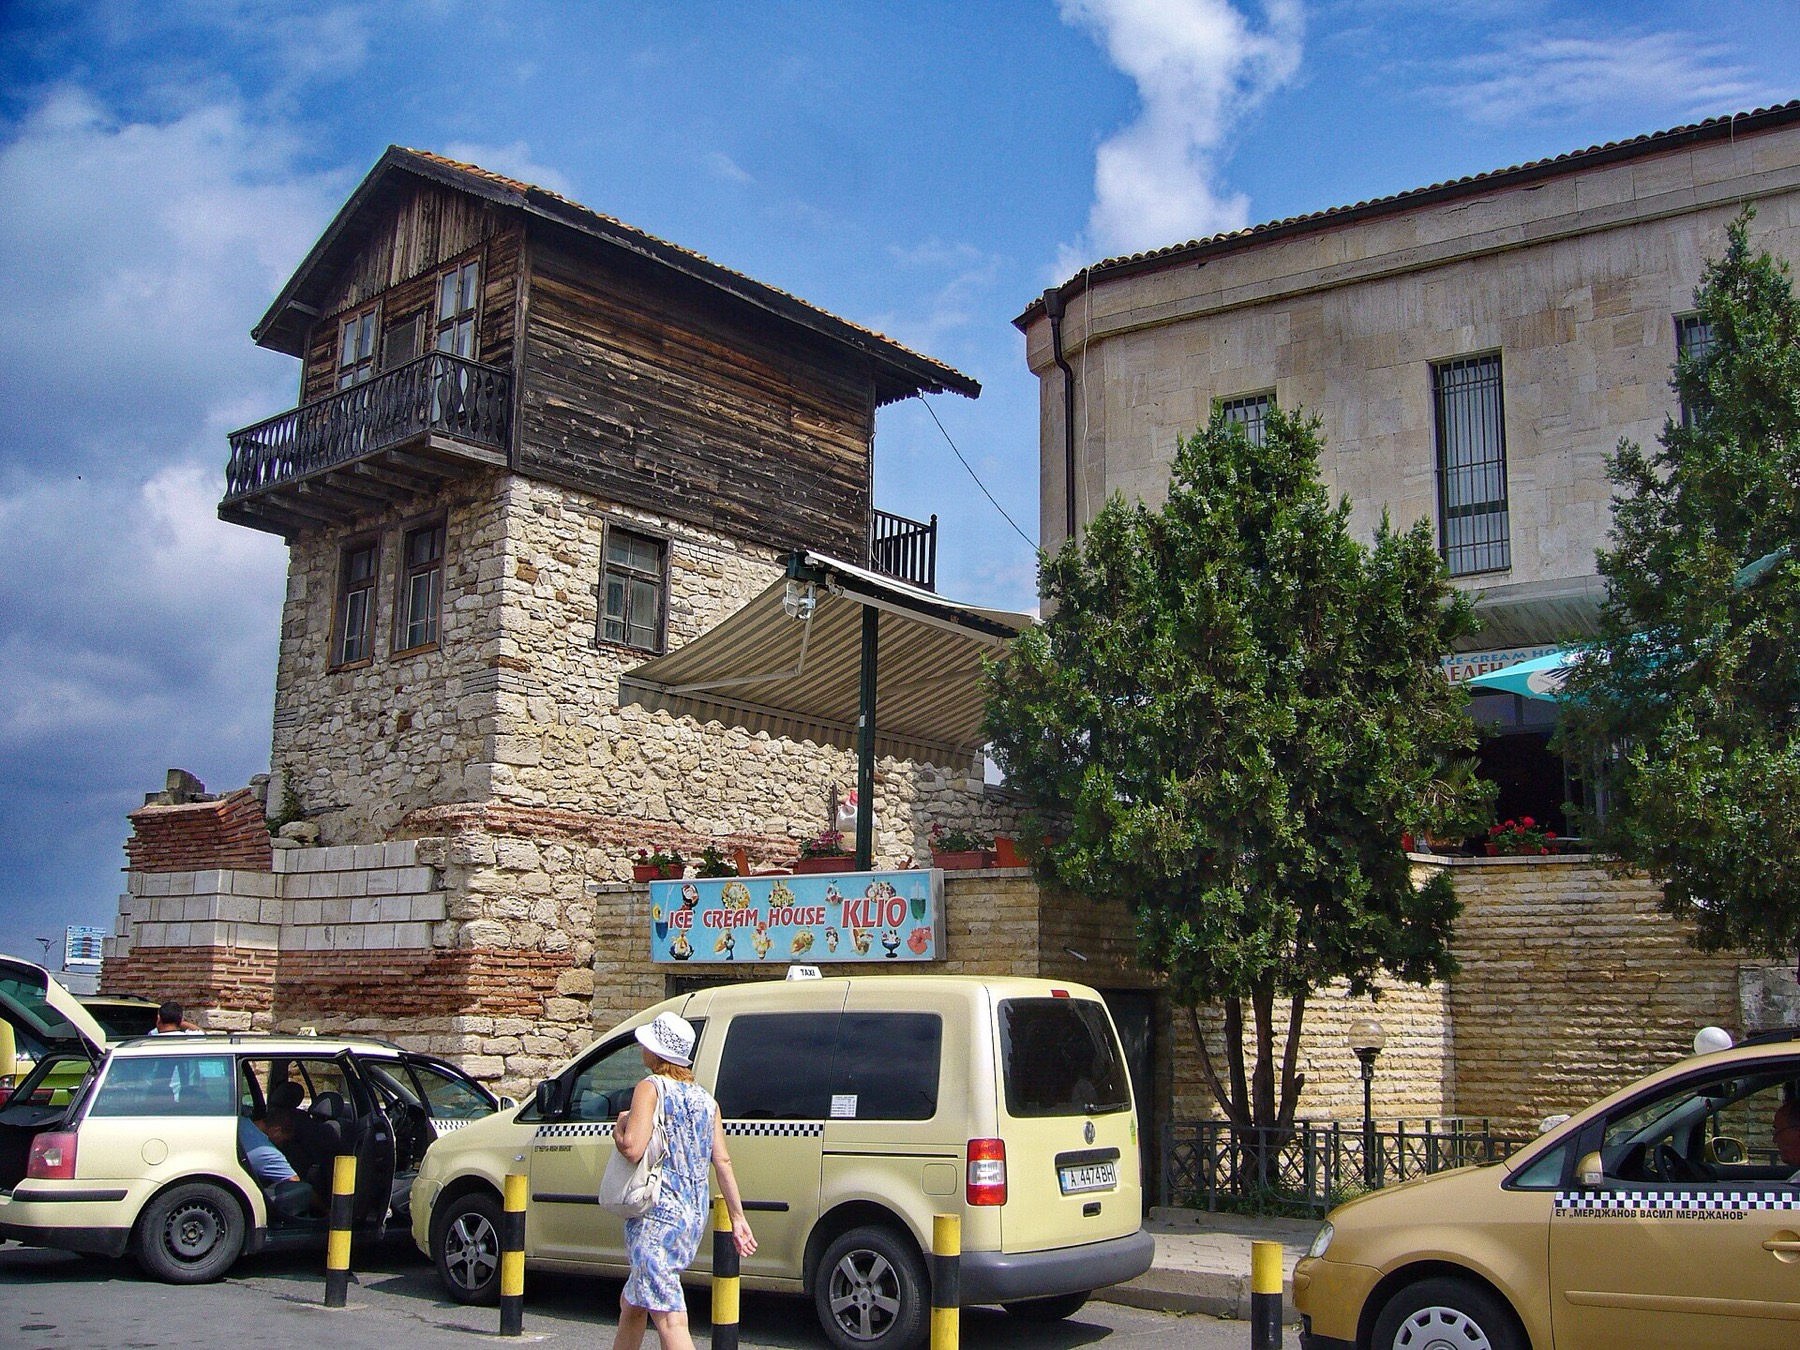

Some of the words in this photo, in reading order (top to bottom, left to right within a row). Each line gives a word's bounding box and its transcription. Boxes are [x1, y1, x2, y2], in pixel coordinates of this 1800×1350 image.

[669, 909, 694, 929] ICE
[702, 908, 758, 930] CREAM
[768, 906, 826, 928] HOUSE
[841, 897, 908, 929] KLIO
[800, 968, 816, 977] TAXI
[1555, 1209, 1567, 1218] ЕТ
[1640, 1209, 1673, 1219] ВАСИЛ
